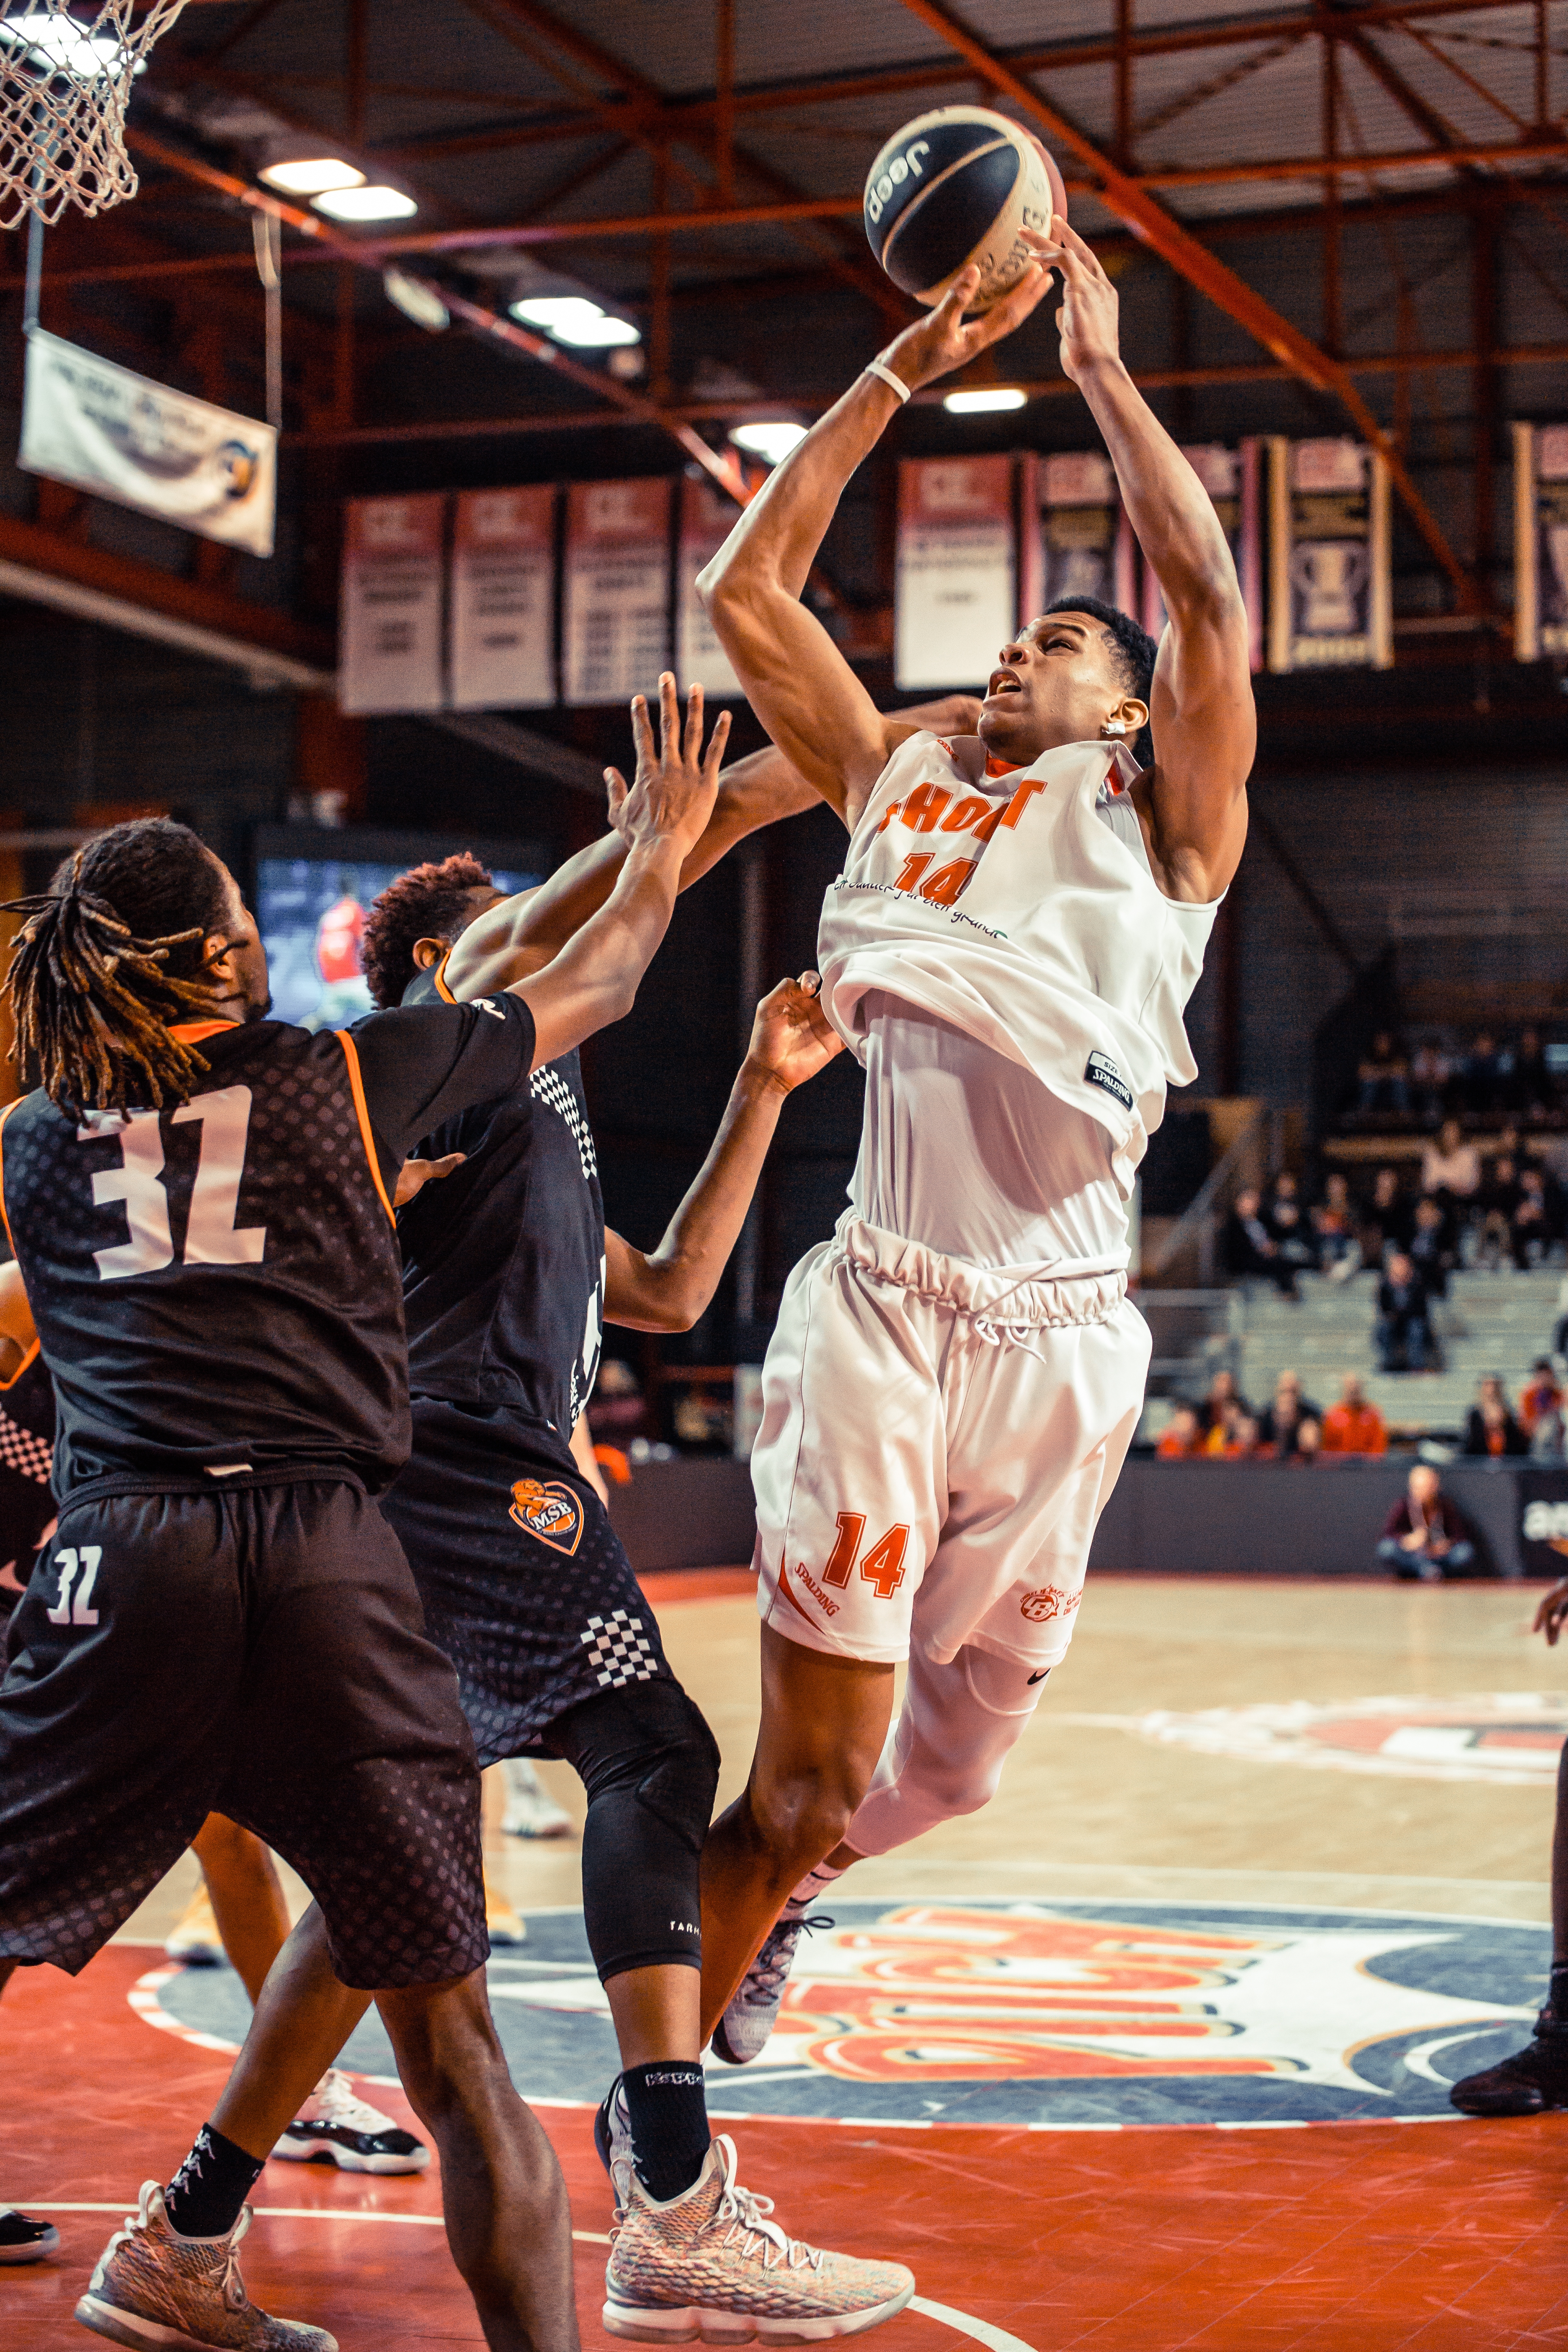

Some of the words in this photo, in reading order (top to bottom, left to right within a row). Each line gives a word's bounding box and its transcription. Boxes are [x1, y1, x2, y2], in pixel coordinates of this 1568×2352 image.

[893, 852, 979, 907] 14
[1093, 1069, 1130, 1104] SPALDING
[77, 1084, 267, 1280] 32
[532, 1502, 572, 1530] MSB
[822, 1511, 911, 1600] 14
[46, 1545, 103, 1625] 32
[795, 1562, 840, 1617] SPALDING
